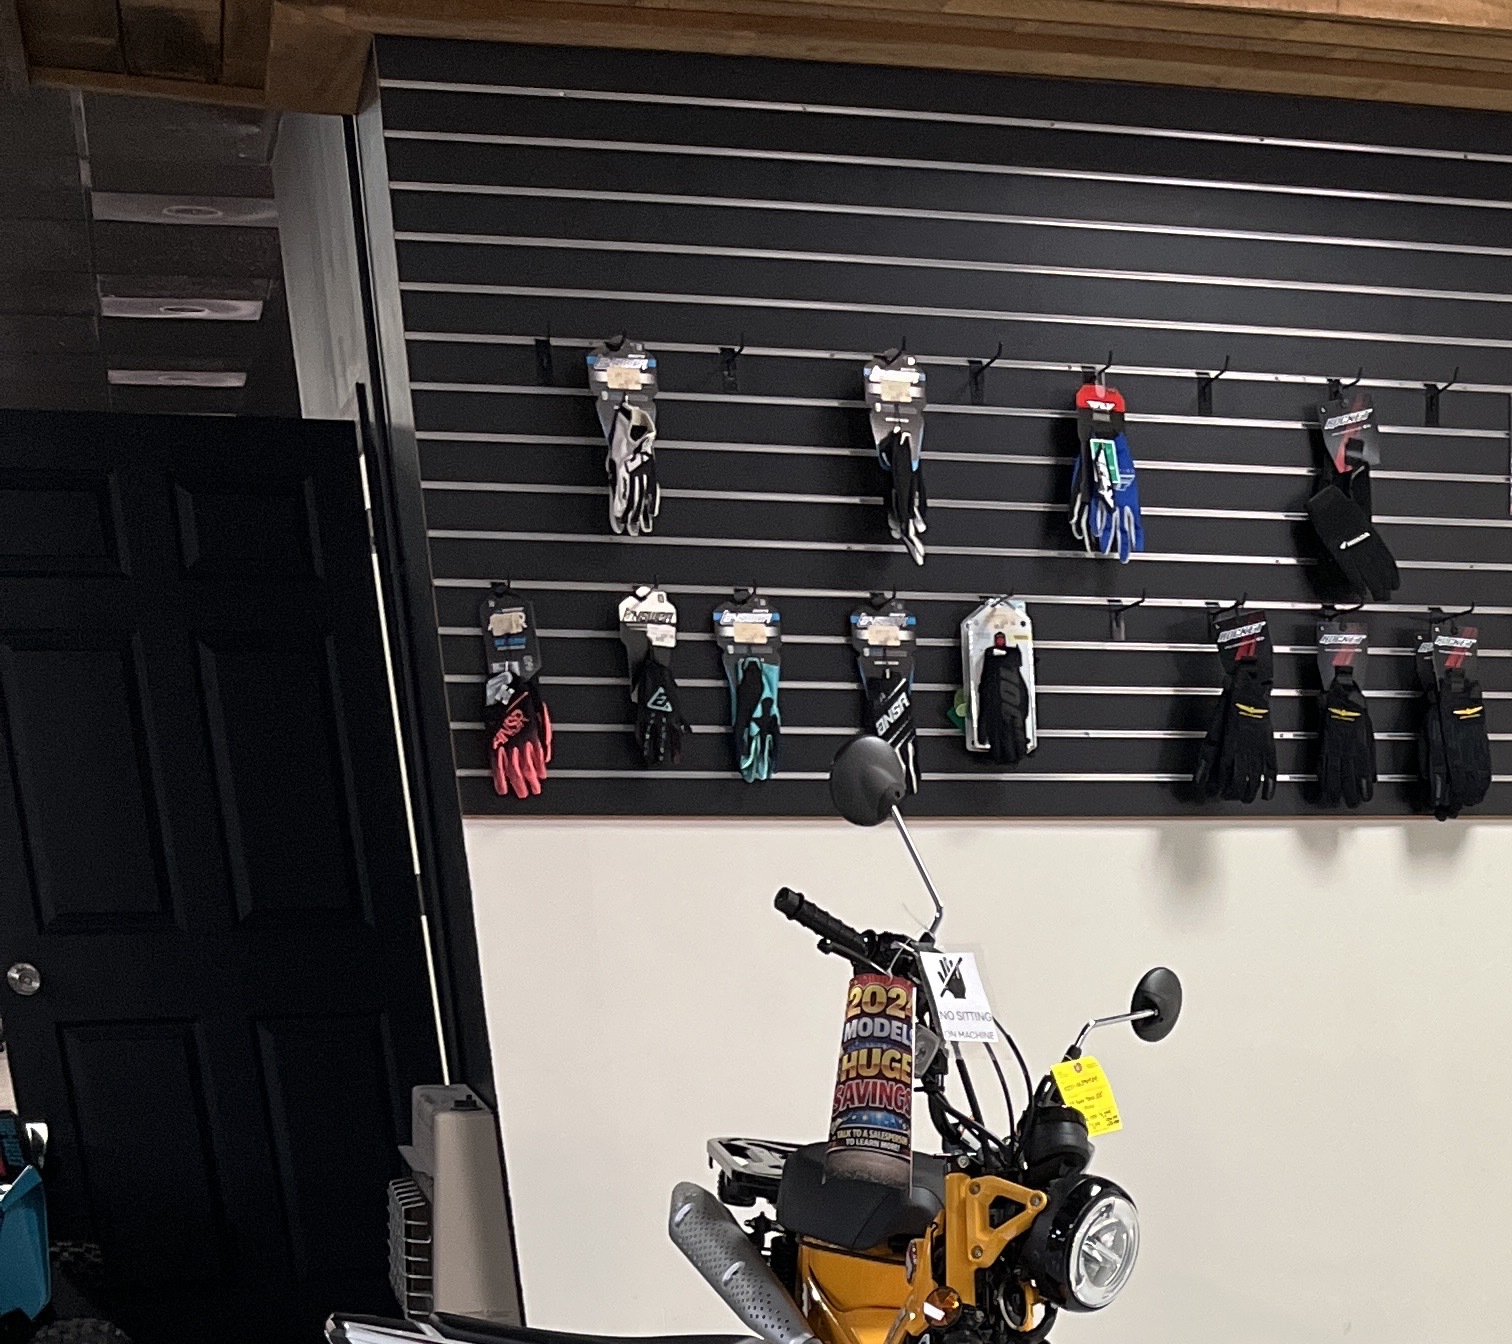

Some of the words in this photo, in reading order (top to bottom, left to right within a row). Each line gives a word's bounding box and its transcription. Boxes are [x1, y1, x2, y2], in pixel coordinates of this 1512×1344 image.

[939, 1010, 955, 1021] NO
[956, 1010, 992, 1022] SITTING
[844, 1017, 913, 1047] MODEL
[957, 1031, 995, 1040] MACHINE
[840, 1048, 912, 1085] HUGE
[852, 1128, 862, 1138] TO
[862, 1129, 869, 1138] A
[845, 1138, 855, 1146] TO
[855, 1138, 880, 1148] LEARN
